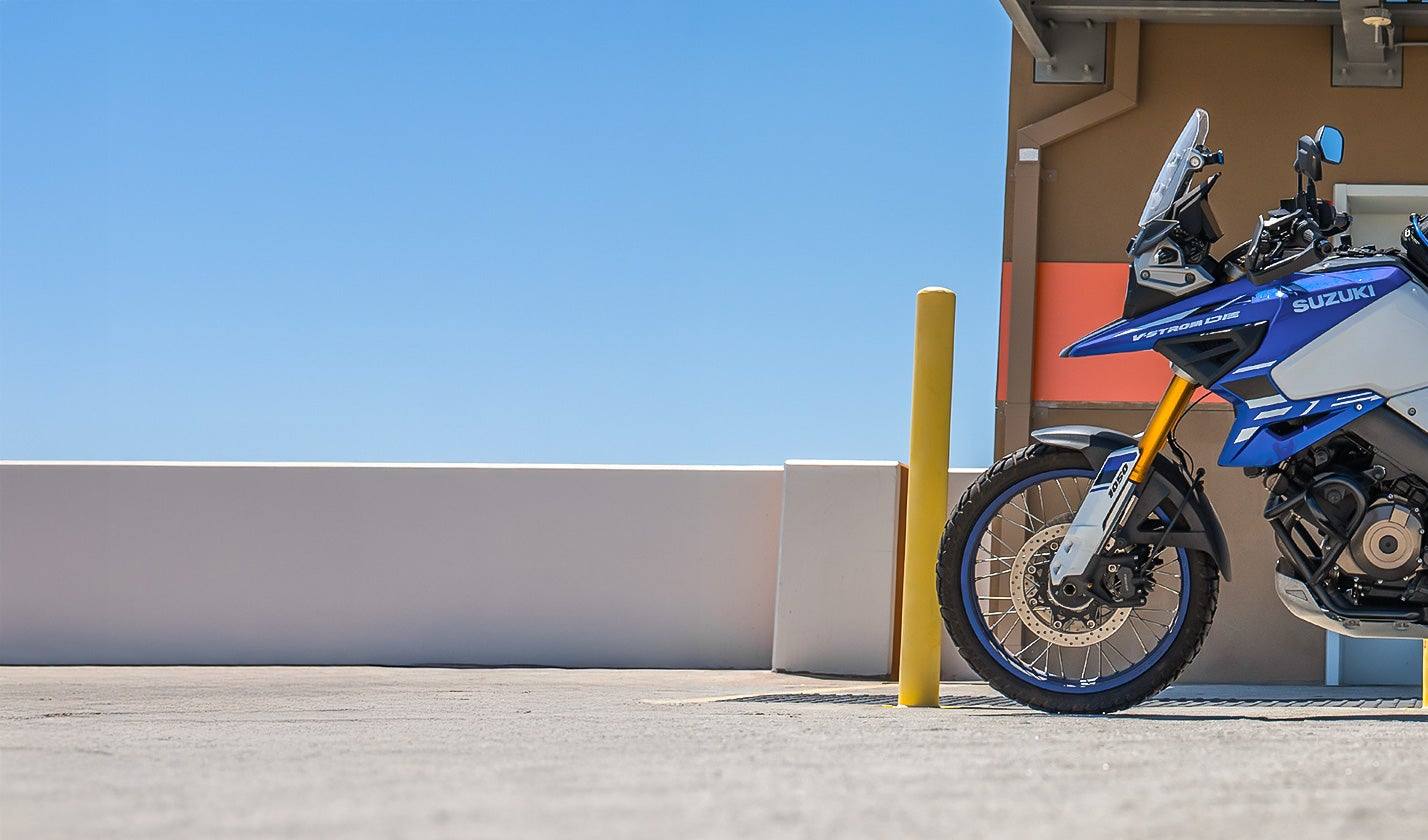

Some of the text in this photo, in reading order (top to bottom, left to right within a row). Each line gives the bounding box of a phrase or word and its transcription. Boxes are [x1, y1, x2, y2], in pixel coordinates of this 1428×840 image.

[1292, 284, 1376, 313] SUZUKI
[1132, 310, 1241, 342] V-STROM DE
[1108, 463, 1129, 499] 1050
